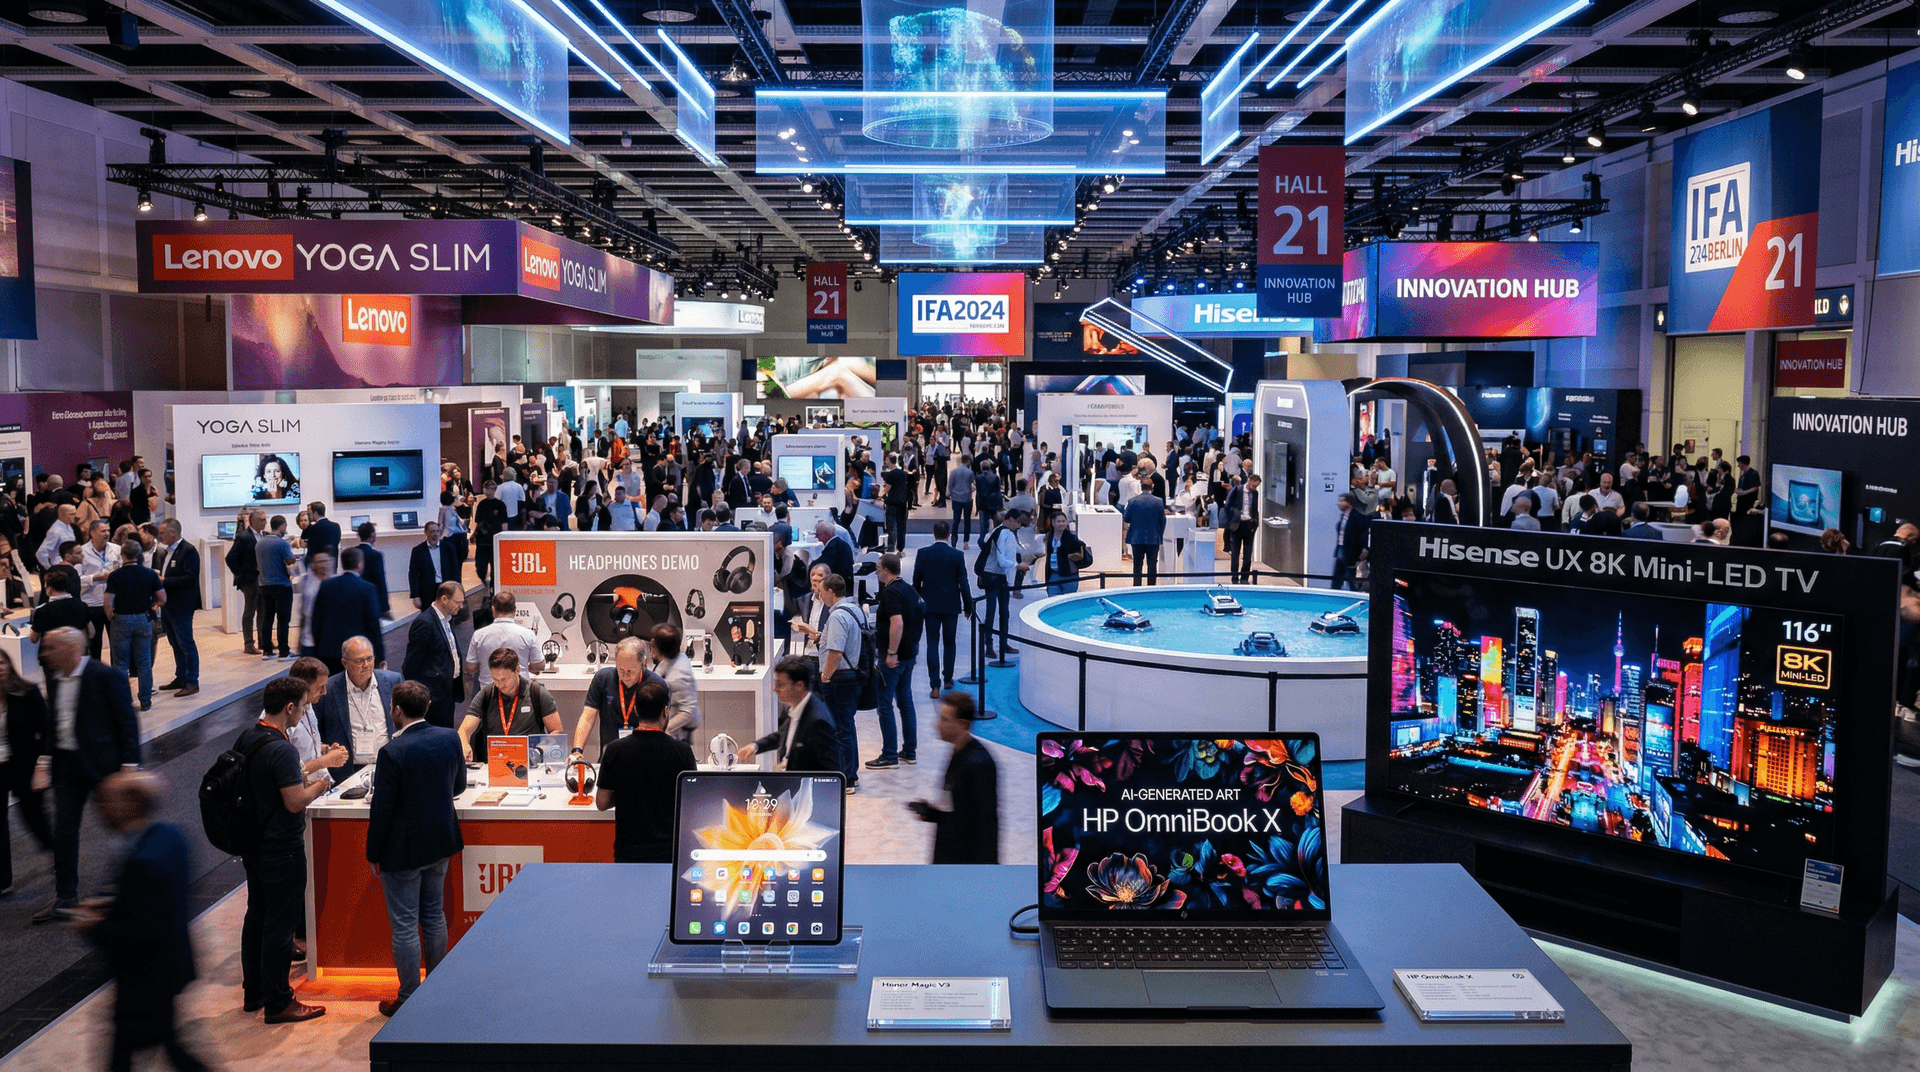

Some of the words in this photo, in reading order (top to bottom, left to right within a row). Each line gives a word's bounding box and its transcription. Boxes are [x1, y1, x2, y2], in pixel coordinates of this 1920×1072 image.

[1274, 174, 1328, 195] HALL
[1690, 178, 1744, 242] IFA
[1272, 204, 1329, 255] 21
[164, 243, 283, 270] Lenovo
[296, 243, 401, 272] YOGA
[409, 242, 491, 272] SLIM
[524, 246, 559, 280] Lenovo
[1764, 231, 1804, 291] 21
[561, 257, 588, 290] YOGA
[588, 265, 607, 295] SLIM
[813, 275, 840, 286] HALL
[1263, 277, 1336, 290] INNOVATION
[1286, 291, 1313, 304] HUB
[1396, 277, 1528, 299] INNOVATION
[1533, 277, 1580, 299] HUB
[813, 290, 840, 315] 21
[917, 299, 1006, 322] IFA2024
[1194, 303, 1301, 324] Hise
[347, 297, 408, 334] Lenovo
[1779, 358, 1825, 371] INNOVATION
[196, 419, 254, 435] YOGA
[257, 418, 301, 434] SLIM
[1792, 412, 1873, 435] INNOVATION
[1876, 414, 1908, 437] HUB
[510, 552, 548, 574] JBL
[569, 554, 658, 571] HEADPHONES
[661, 554, 700, 571] DEMO
[1418, 536, 1540, 568] Hisense
[1545, 548, 1583, 573] UX
[1589, 551, 1627, 576] 8K
[1633, 554, 1767, 589] Mini-LED
[1775, 565, 1820, 594] TV
[1782, 620, 1832, 643] 116"
[1783, 652, 1825, 673] 8K
[1780, 670, 1826, 683] MINI-LED
[1121, 788, 1214, 801] AI-GENERATED
[1216, 788, 1241, 801] ART
[1083, 807, 1120, 833] HP
[1125, 807, 1259, 834] OmniBook
[1261, 807, 1283, 833] X
[477, 863, 521, 894] JB
[911, 981, 937, 989] Magic
